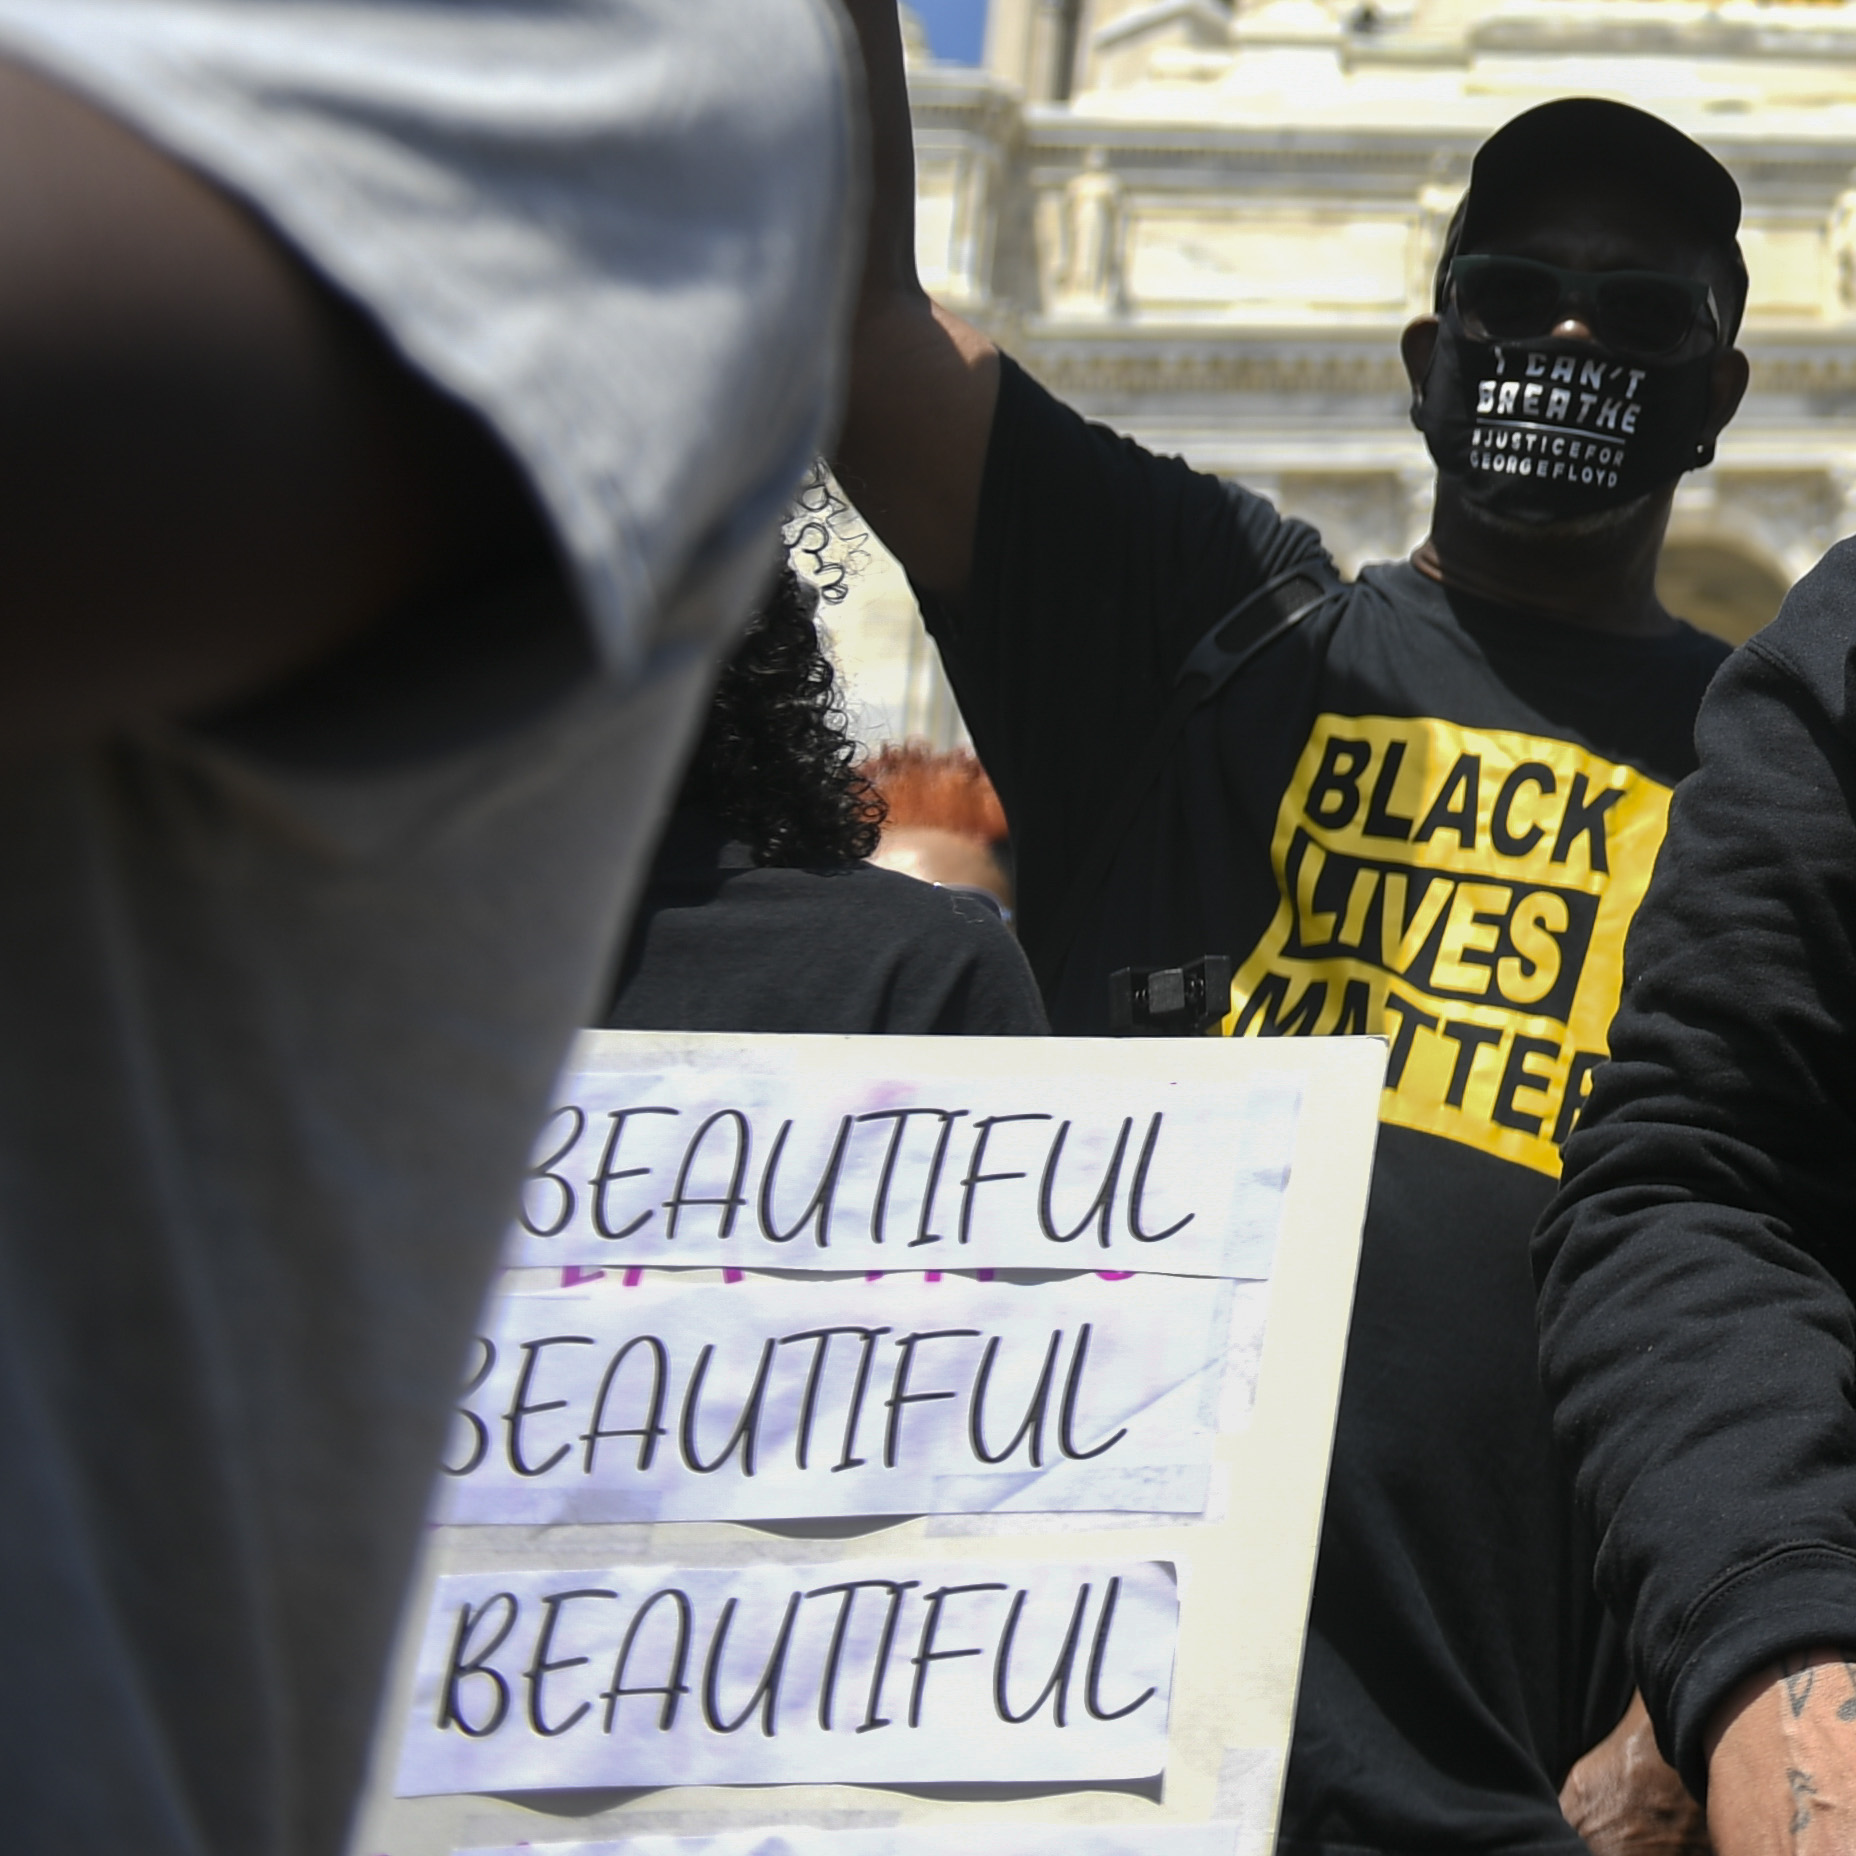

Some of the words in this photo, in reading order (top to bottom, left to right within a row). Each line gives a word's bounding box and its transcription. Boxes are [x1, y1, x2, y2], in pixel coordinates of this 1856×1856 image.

[1476, 380, 1642, 434] BREATHE
[1525, 352, 1647, 400] CAN'T
[1470, 449, 1618, 488] GEORGEFLOYD
[1302, 735, 1626, 877] BLACK
[1296, 842, 1570, 1004] LIVES
[517, 1105, 1196, 1250] BEAUTIFUL
[437, 1576, 1158, 1738] BEAUTIFUL
